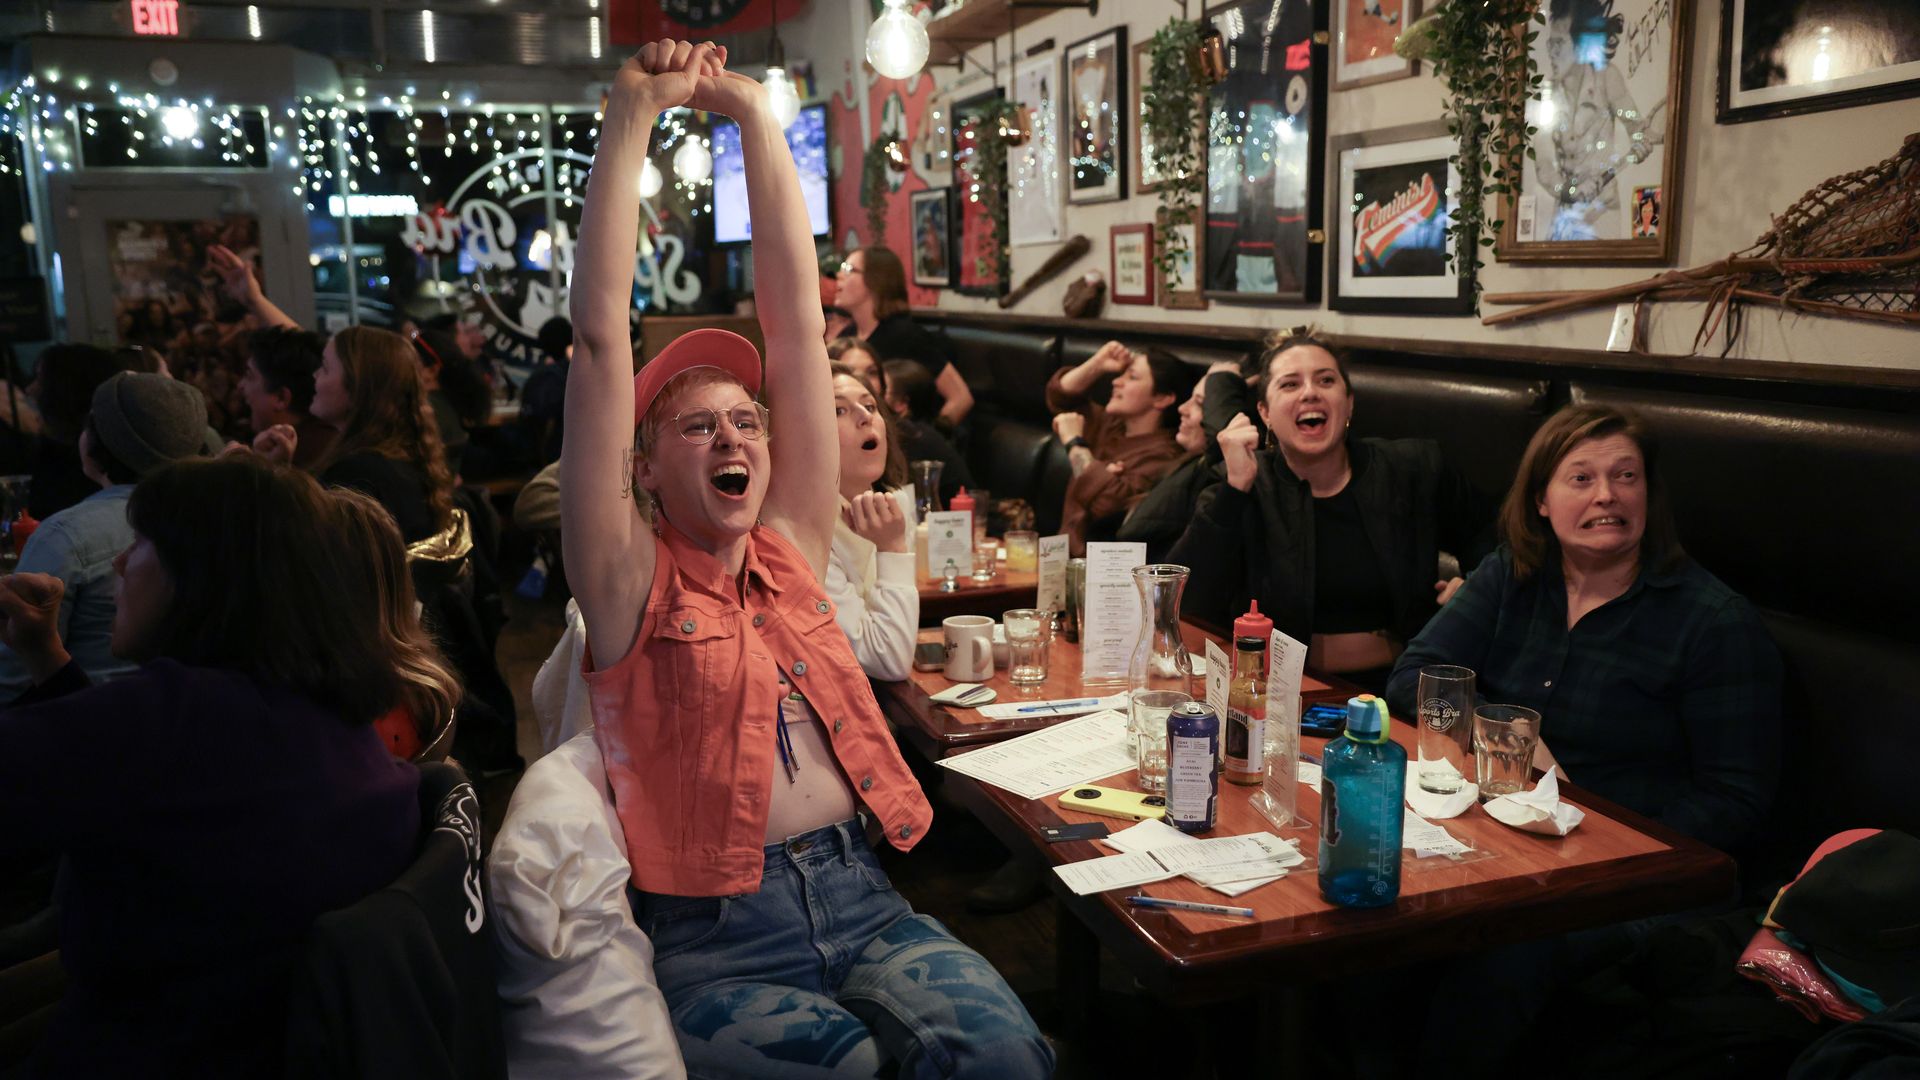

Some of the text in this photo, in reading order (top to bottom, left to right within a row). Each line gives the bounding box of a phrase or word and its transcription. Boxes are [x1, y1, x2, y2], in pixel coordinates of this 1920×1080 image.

[131, 0, 179, 35] EXIT
[1354, 172, 1434, 257] Feminist
[1442, 707, 1461, 718] Bra
